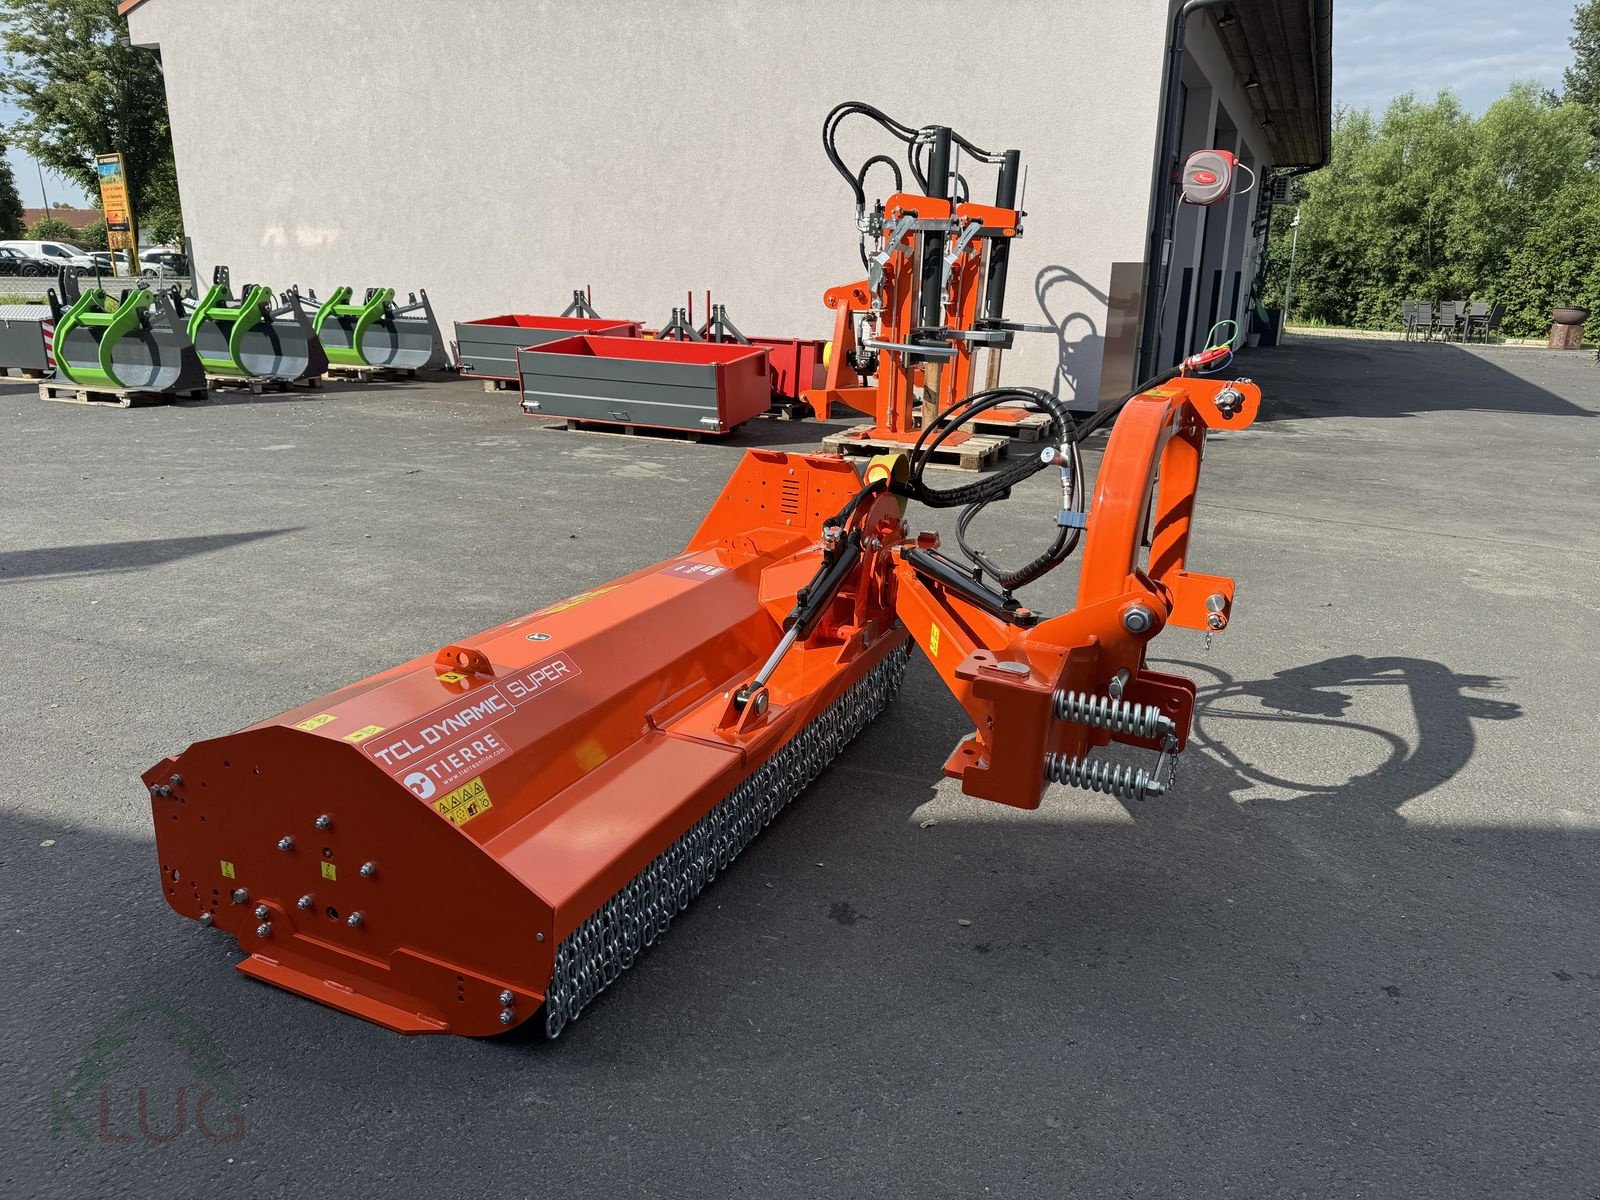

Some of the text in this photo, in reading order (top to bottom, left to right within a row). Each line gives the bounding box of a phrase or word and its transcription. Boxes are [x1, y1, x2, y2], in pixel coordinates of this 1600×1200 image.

[374, 659, 571, 766] TCL DYNAMIC SUPER
[425, 733, 499, 779] TIERRE
[443, 747, 506, 786] www.tierreonline.com
